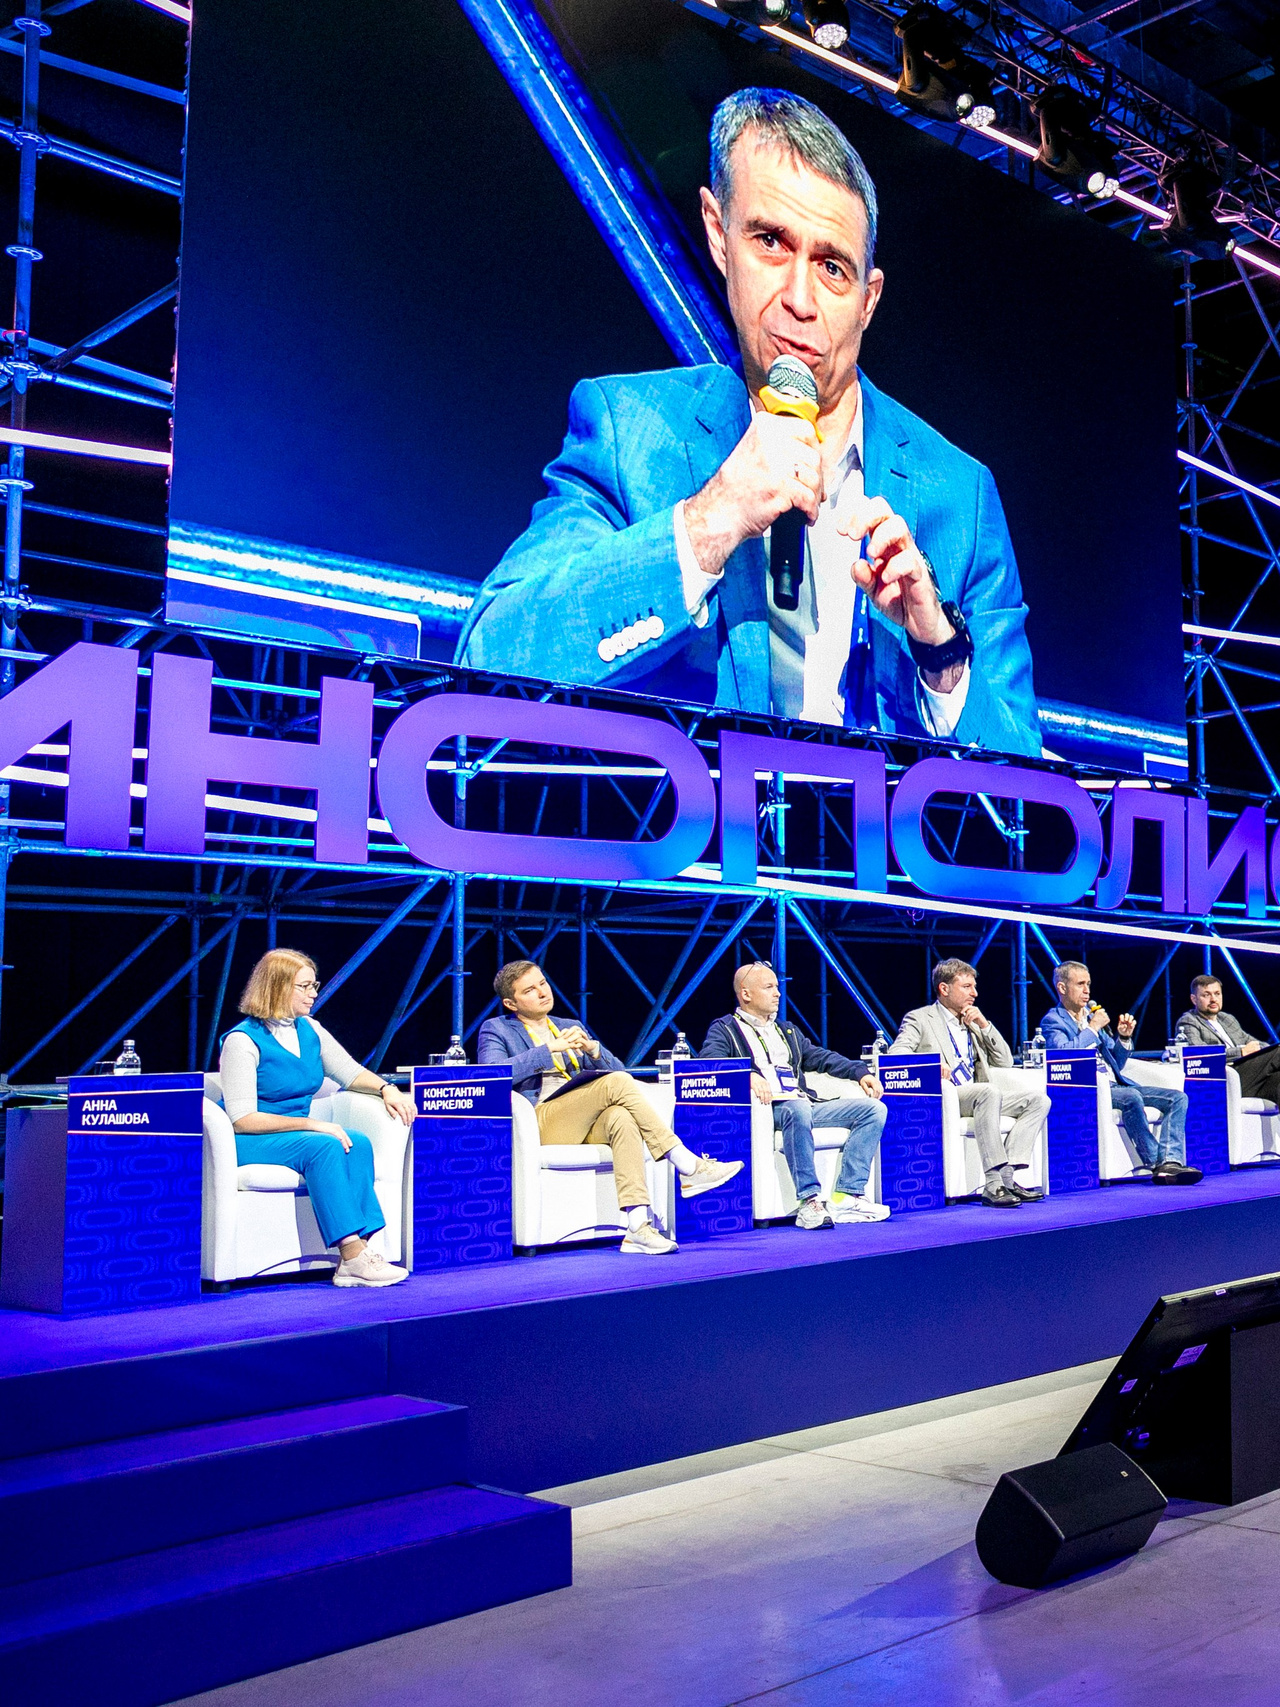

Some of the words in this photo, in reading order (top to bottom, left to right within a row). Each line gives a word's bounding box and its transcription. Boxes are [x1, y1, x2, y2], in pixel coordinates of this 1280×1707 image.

[884, 1069, 909, 1080] СЕРГЕЙ
[681, 1075, 717, 1089] ДМИТРИЙ
[423, 1086, 486, 1099] КОНСТАНТИН
[681, 1087, 731, 1099] МАРКОСЬЯНЦ
[82, 1099, 118, 1112] АННА
[423, 1098, 474, 1111] МАРКЕЛОВ
[82, 1112, 150, 1126] КУЛАШОВА
